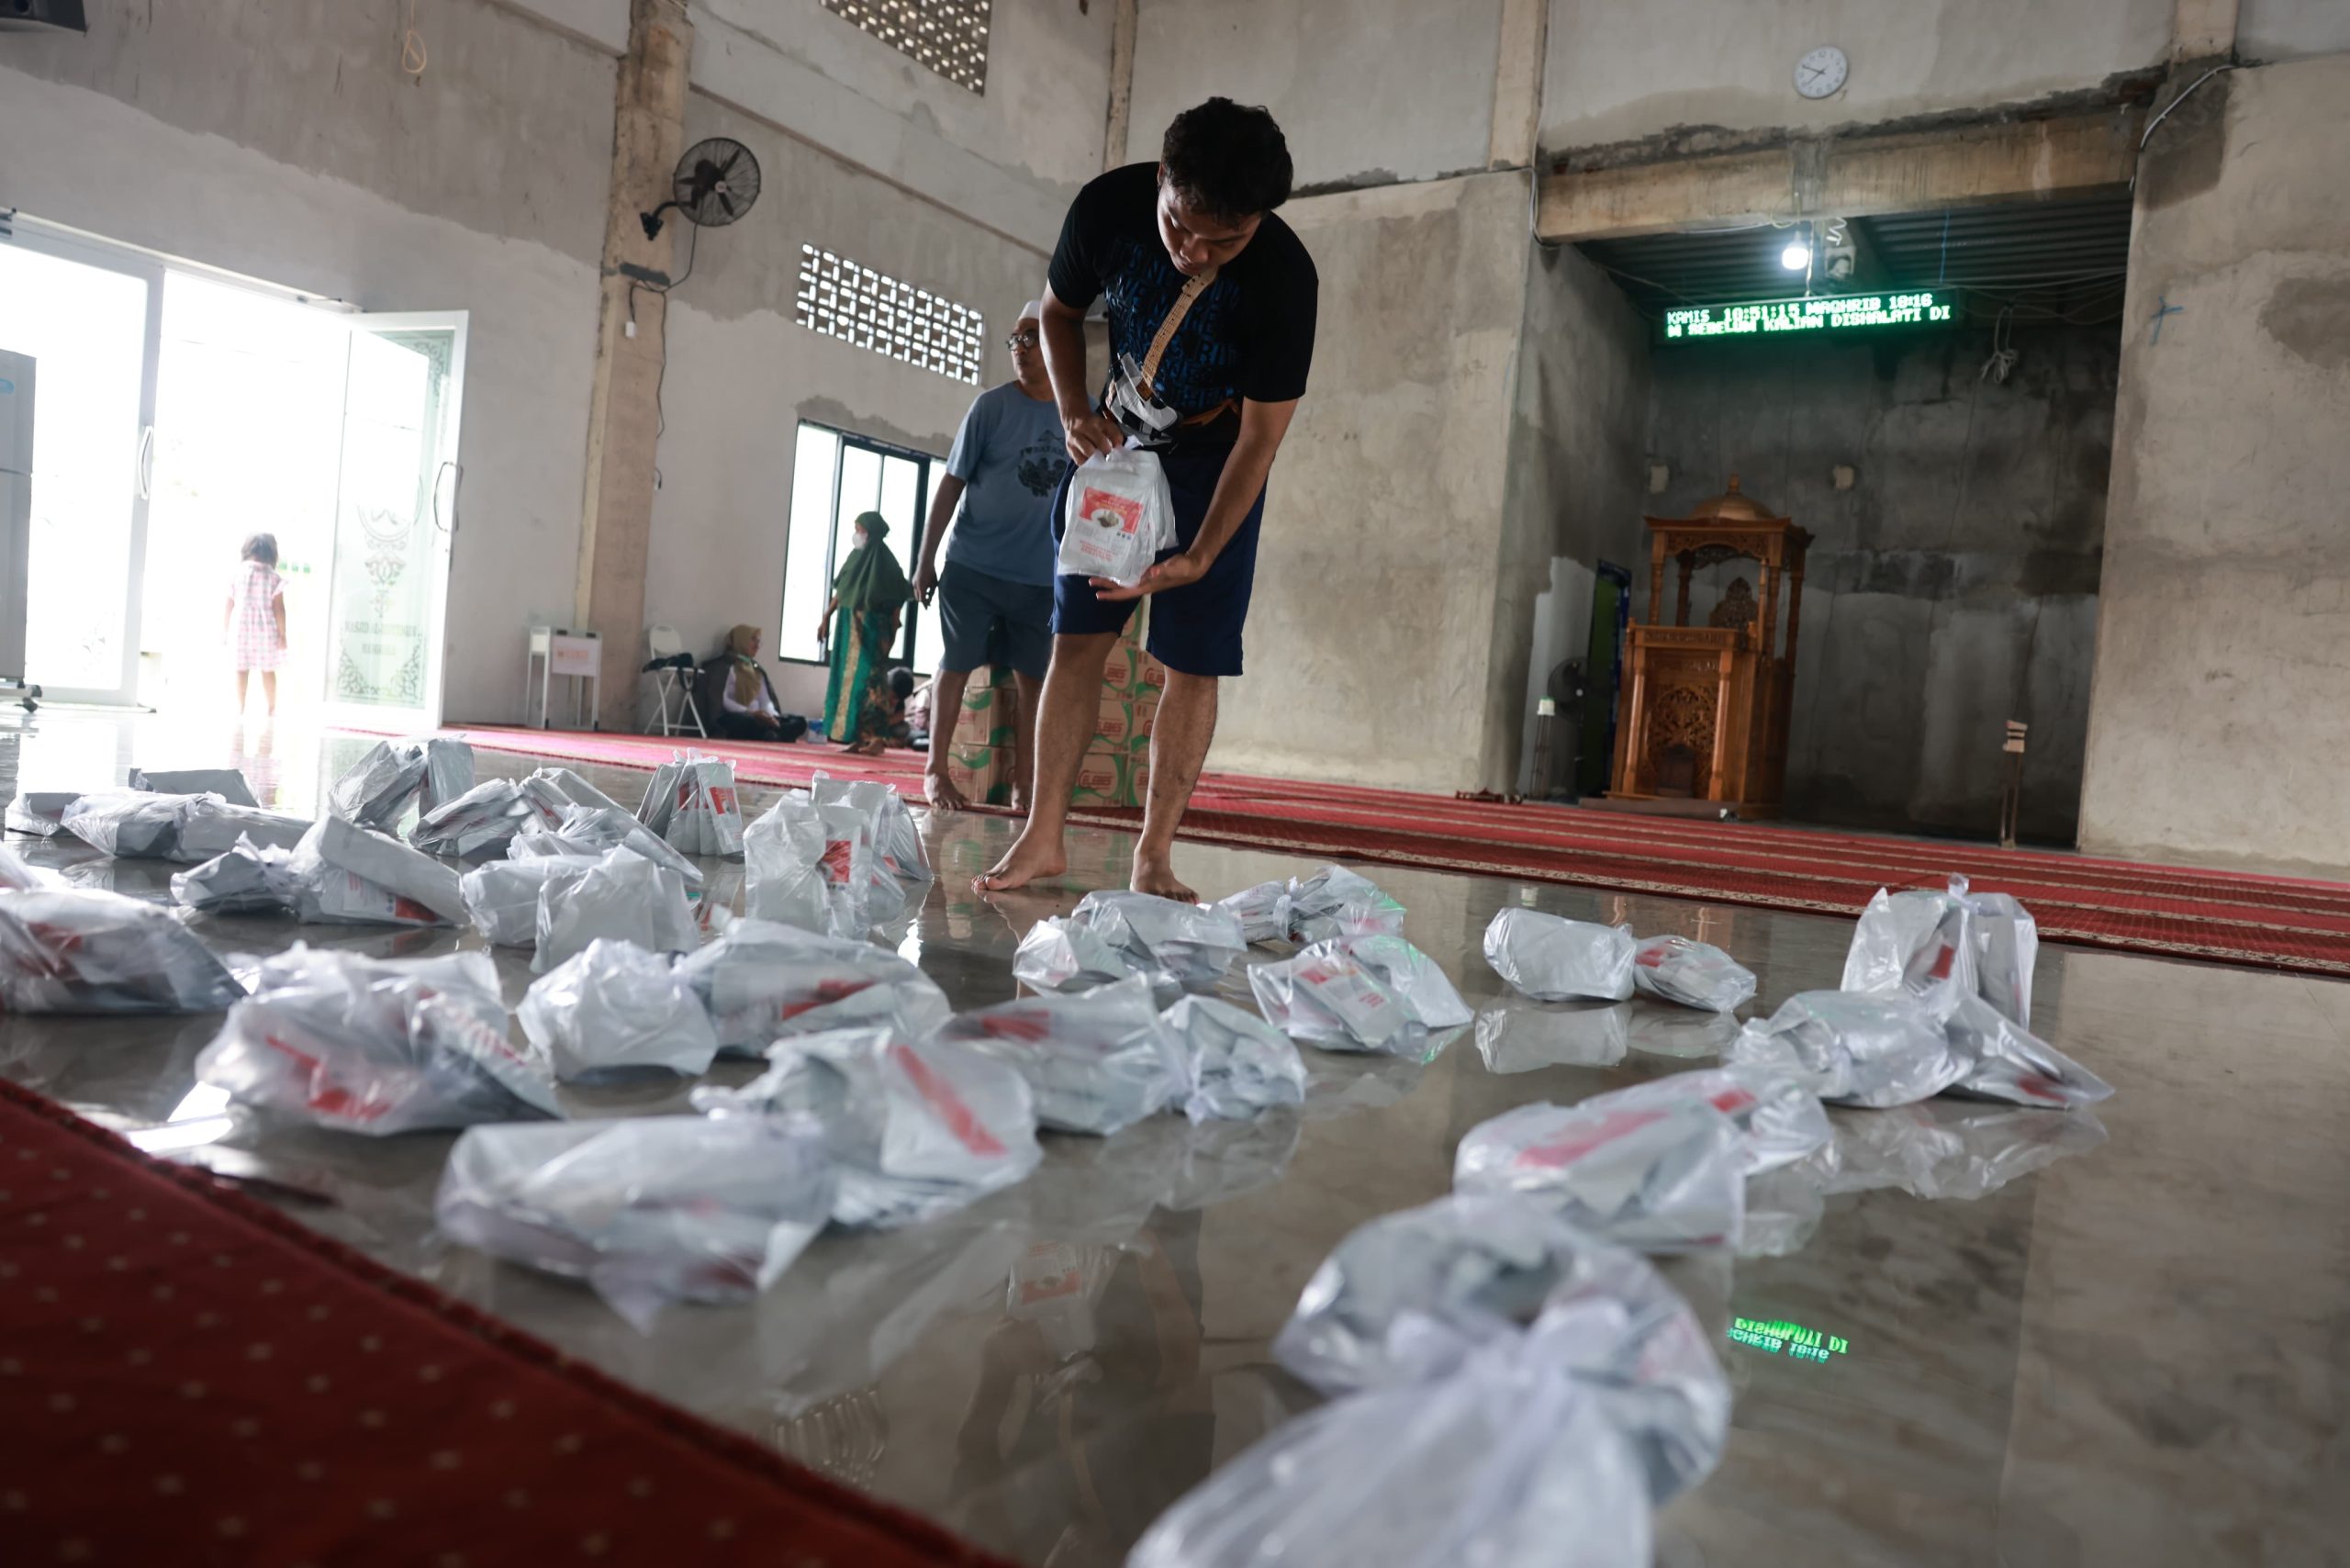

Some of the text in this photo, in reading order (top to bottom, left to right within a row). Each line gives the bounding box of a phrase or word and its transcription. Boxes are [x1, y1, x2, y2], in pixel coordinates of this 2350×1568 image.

[1668, 309, 1709, 324] KAMIS
[1806, 297, 1881, 315] MAGHRIB
[1890, 293, 1932, 309] 18:16
[1688, 319, 1757, 335] SEBELUM
[1763, 315, 1823, 331] KALIAN
[1831, 308, 1921, 326] DISHALATI
[1930, 306, 1950, 319] DI
[1079, 769, 1113, 790] CELEBES
